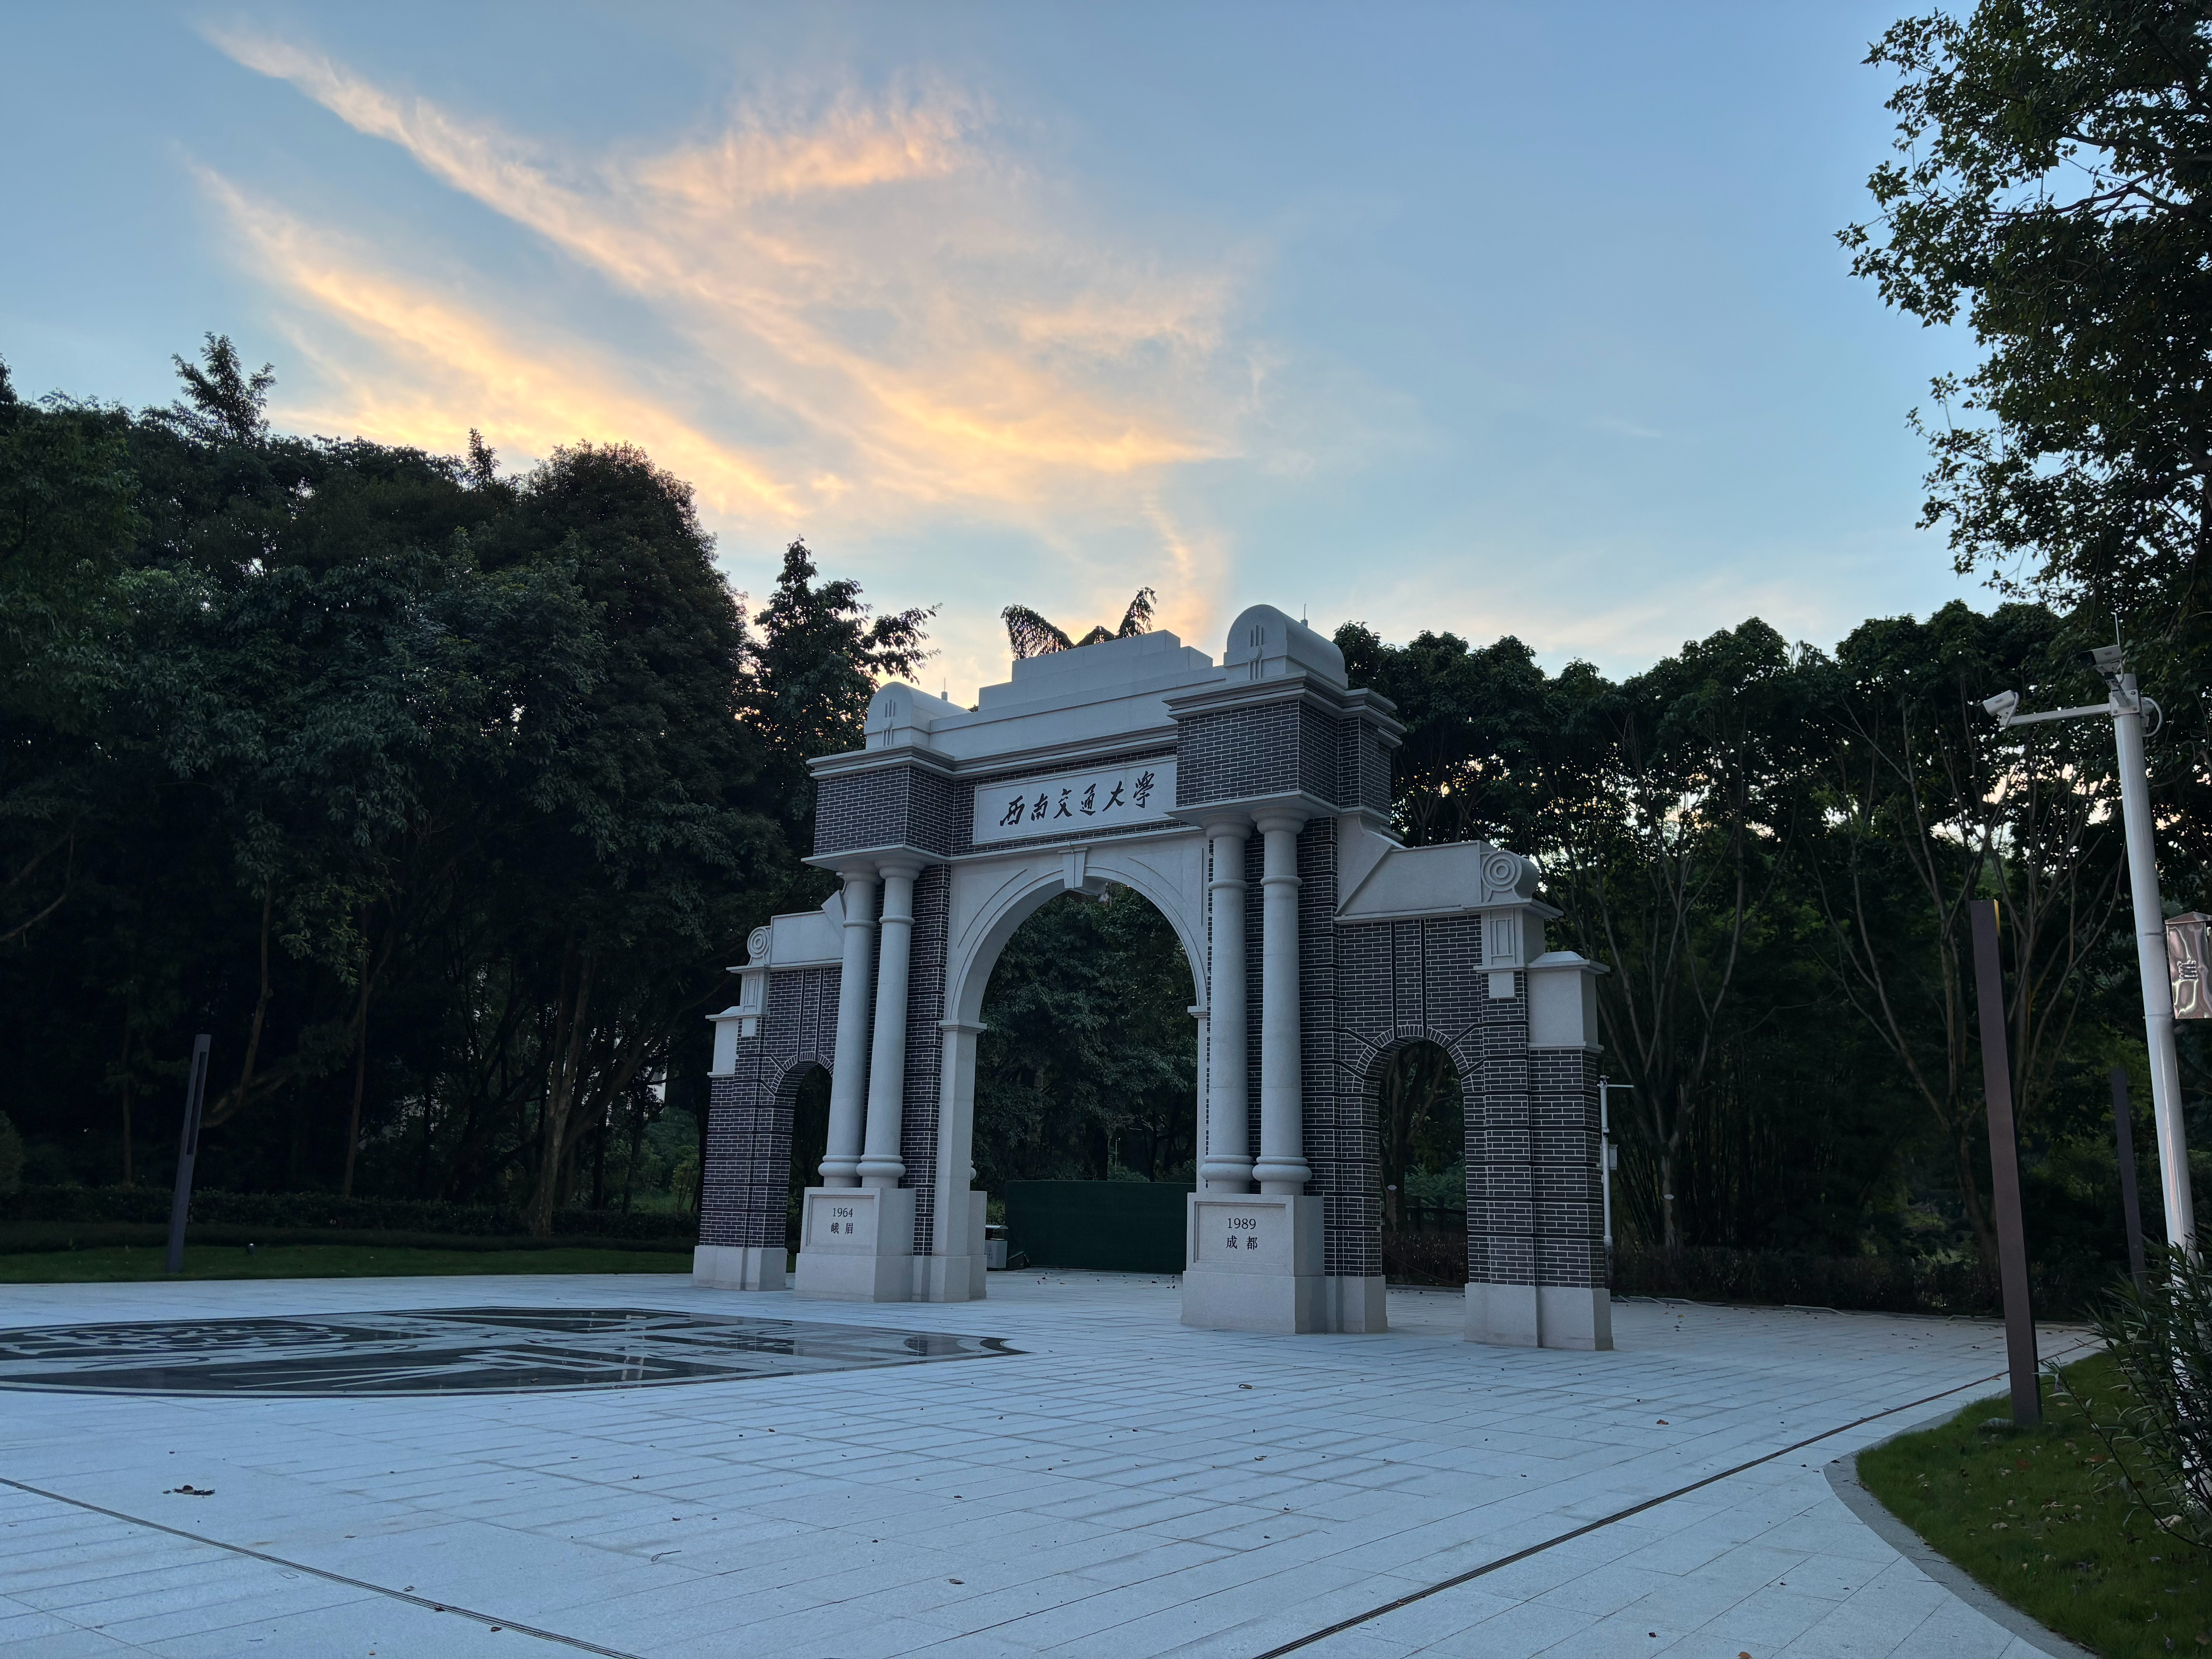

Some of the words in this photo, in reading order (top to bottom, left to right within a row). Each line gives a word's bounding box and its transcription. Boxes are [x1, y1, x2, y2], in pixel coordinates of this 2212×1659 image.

[832, 1207, 853, 1217] 1964
[831, 1222, 853, 1235] 峨眉
[1227, 1218, 1256, 1230] 1989
[1226, 1235, 1258, 1250] 成都
